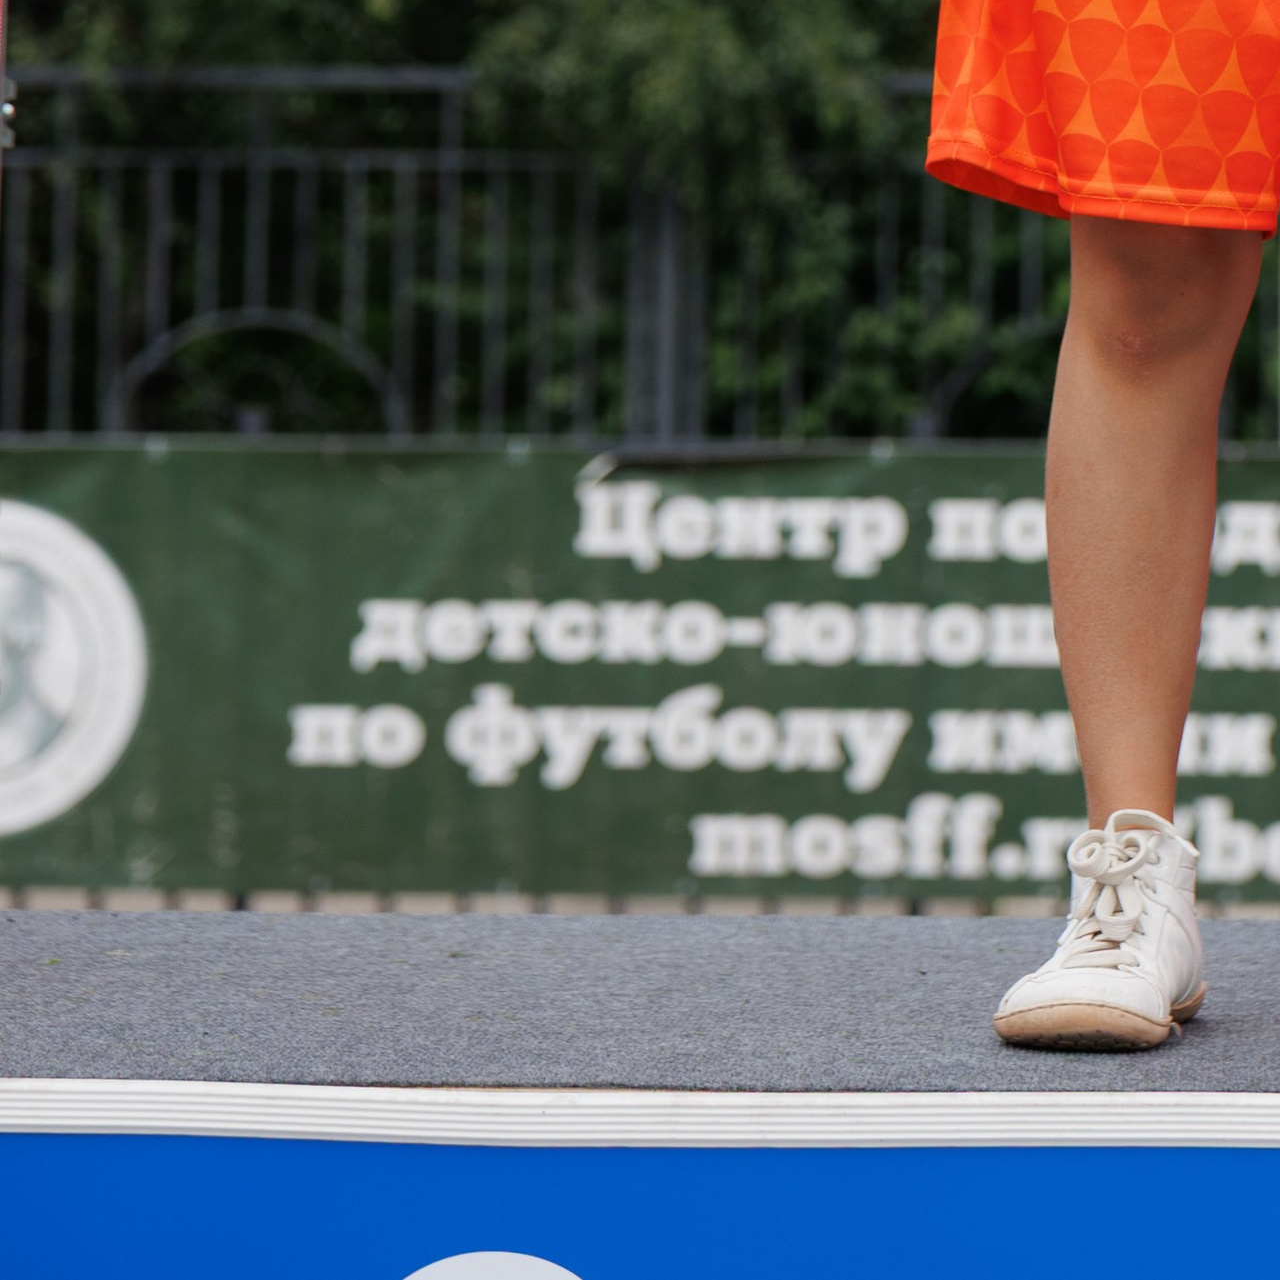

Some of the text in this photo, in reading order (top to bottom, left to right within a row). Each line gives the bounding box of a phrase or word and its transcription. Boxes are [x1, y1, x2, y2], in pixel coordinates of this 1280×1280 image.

[574, 479, 908, 577] Центр
[287, 704, 427, 769] по
[444, 682, 911, 793] футболу
